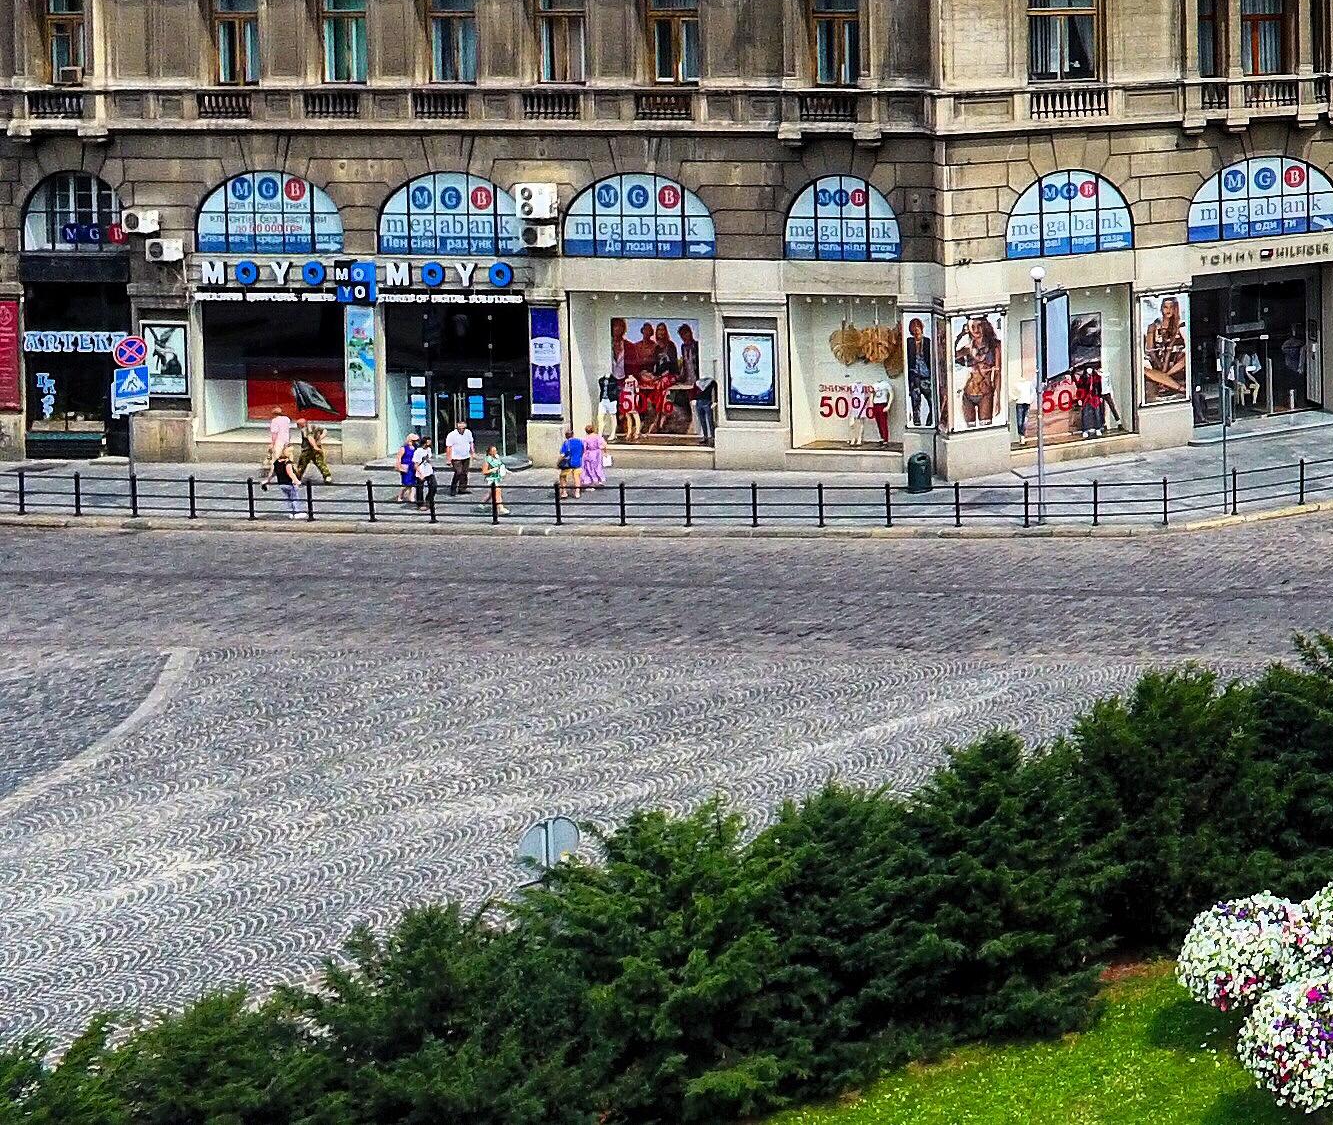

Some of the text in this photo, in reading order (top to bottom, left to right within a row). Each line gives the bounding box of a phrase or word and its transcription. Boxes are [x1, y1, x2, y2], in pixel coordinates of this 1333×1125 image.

[1201, 195, 1323, 223] megabank
[386, 216, 511, 235] megabank
[575, 217, 698, 239] megabank
[789, 222, 891, 240] megabank
[1011, 213, 1122, 236] megabank
[1201, 253, 1254, 266] TOMMY
[201, 260, 326, 286] MOYO
[386, 262, 514, 287] MOYO
[820, 396, 875, 419] 50%
